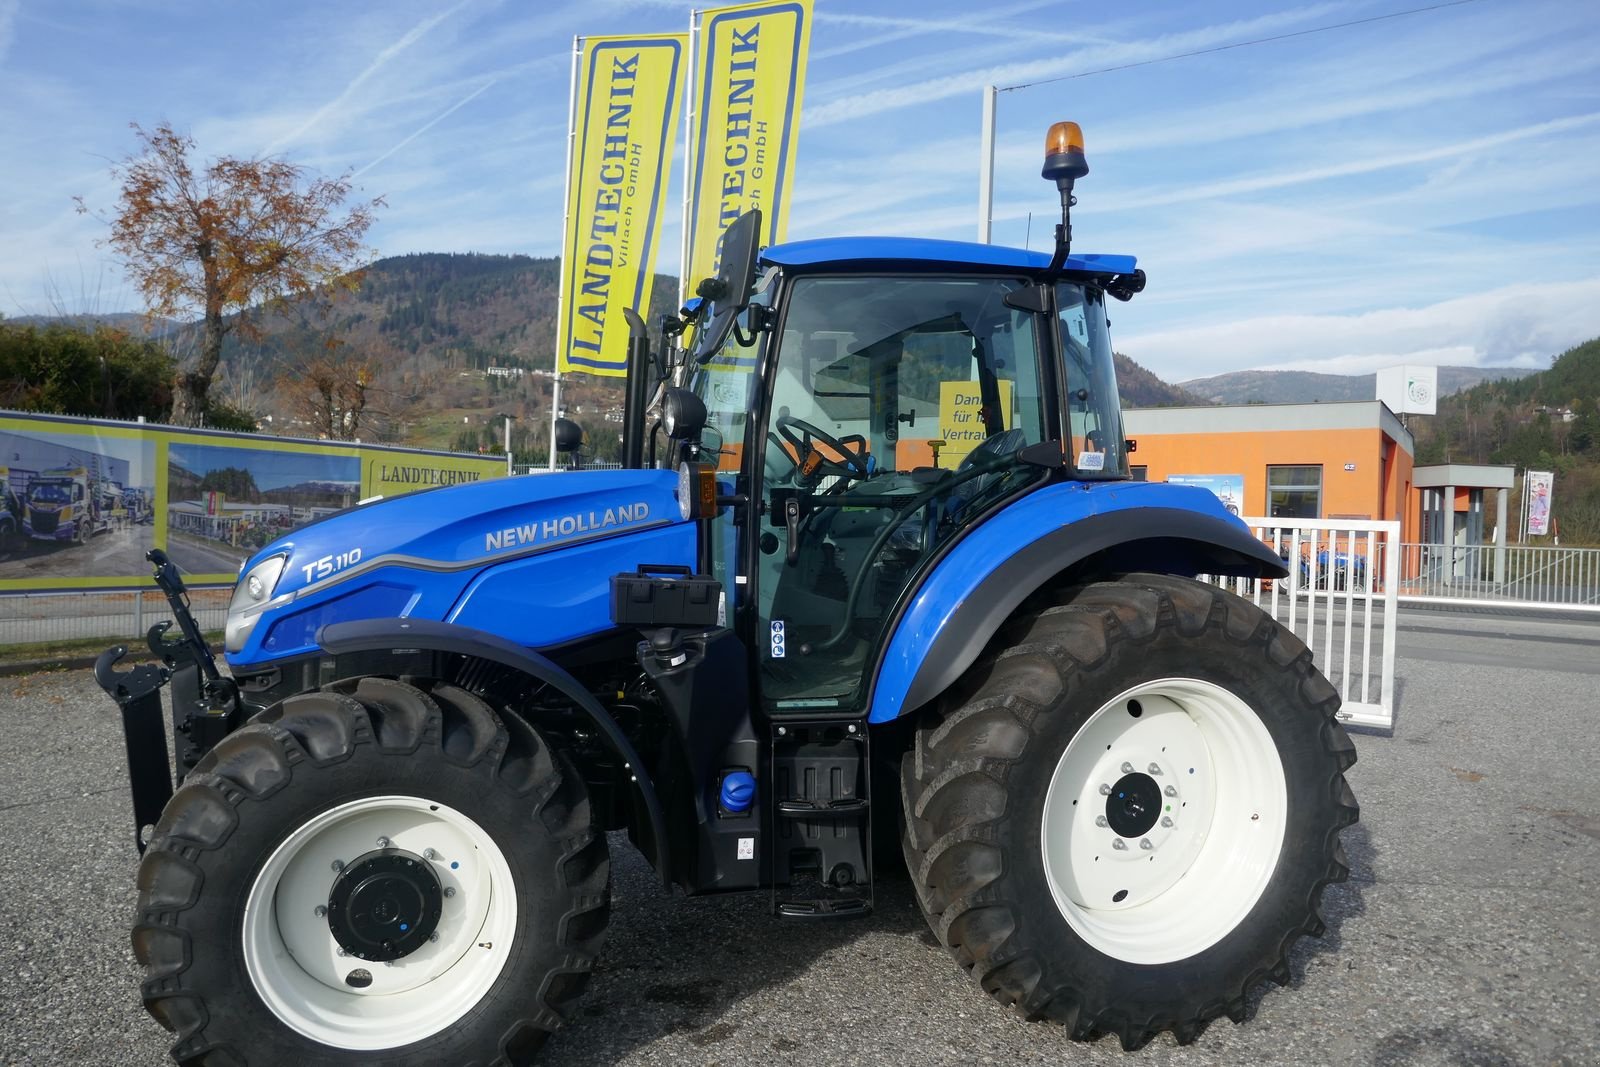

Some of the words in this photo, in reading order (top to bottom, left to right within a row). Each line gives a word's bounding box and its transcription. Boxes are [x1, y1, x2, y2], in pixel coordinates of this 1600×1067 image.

[752, 121, 767, 179] GmbH
[573, 53, 640, 354] LANDTECHNIK
[618, 206, 632, 267] Villach
[626, 143, 642, 197] GmbH
[953, 410, 972, 423] für
[955, 394, 982, 406] Dan
[943, 428, 987, 440] Vertrau
[381, 465, 480, 486] LANDTECHNIK
[485, 523, 537, 551] NEW
[543, 502, 649, 539] HOLLAND
[302, 548, 361, 583] T5.110
